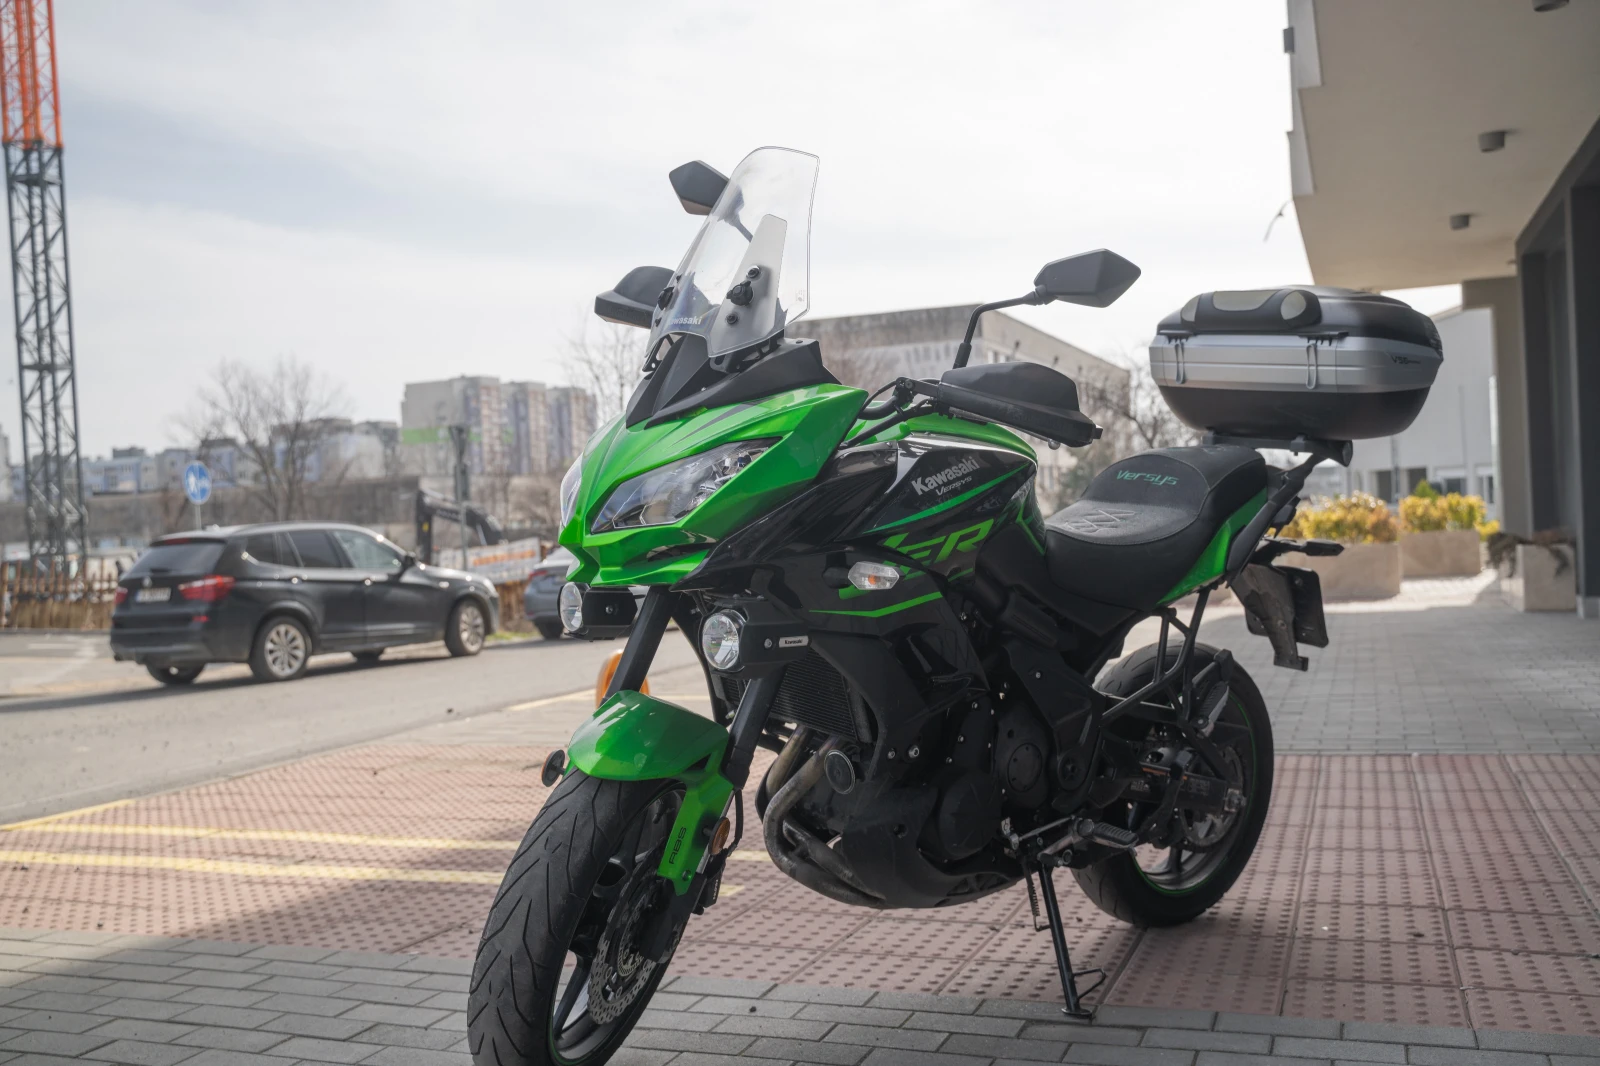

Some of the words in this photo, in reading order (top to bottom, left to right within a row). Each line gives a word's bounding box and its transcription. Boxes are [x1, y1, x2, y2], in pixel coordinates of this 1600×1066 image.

[911, 456, 980, 495] Kawasaki
[1116, 470, 1179, 485] Versys
[669, 827, 687, 865] ABS
